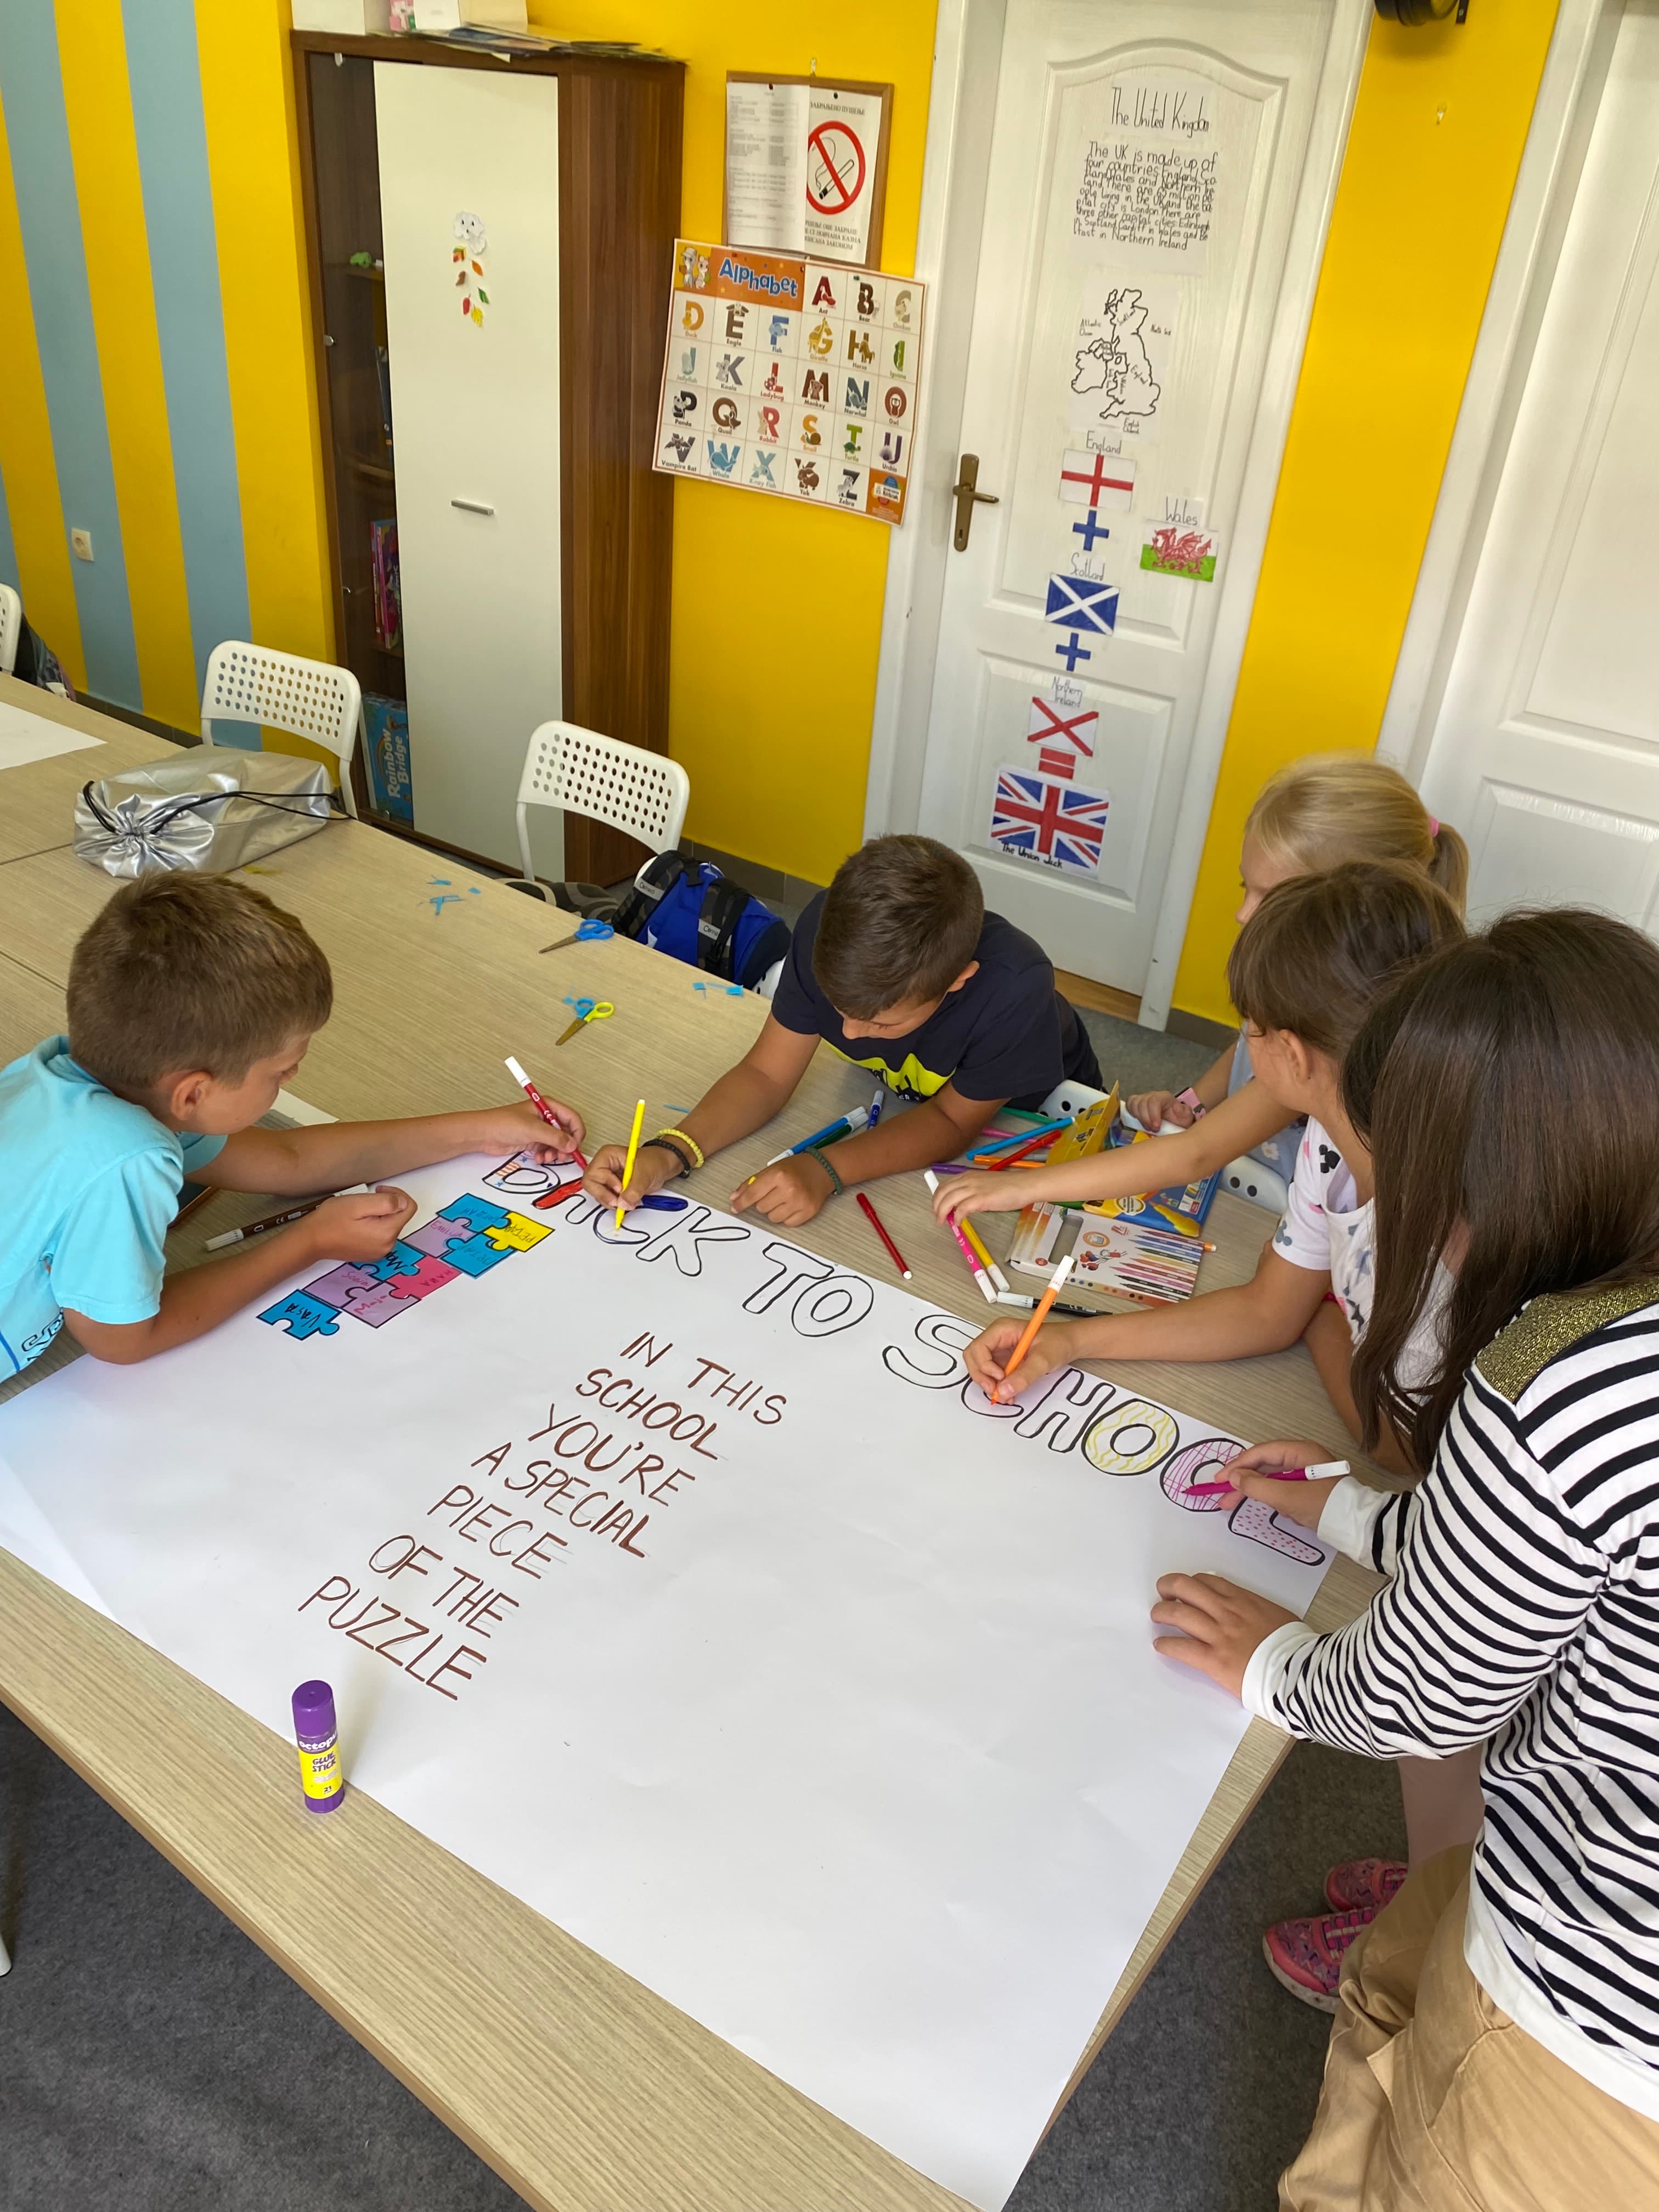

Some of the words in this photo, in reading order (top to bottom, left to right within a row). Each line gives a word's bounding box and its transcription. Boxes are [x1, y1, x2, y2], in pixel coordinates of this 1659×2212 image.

[1111, 87, 1128, 125] The
[1134, 88, 1167, 128] United
[1085, 154, 1104, 168] four
[1089, 141, 1108, 157] The
[1115, 144, 1128, 160] UK
[1134, 149, 1142, 163] is
[1147, 148, 1181, 166] made
[1184, 159, 1198, 172] up
[1201, 152, 1218, 172] of
[1139, 173, 1158, 186] and
[1137, 186, 1153, 195] are
[1125, 195, 1132, 203] in
[1121, 203, 1126, 212] is
[1112, 229, 1154, 246] Northern
[1159, 234, 1188, 250] Ireland
[1183, 228, 1198, 239] and
[718, 258, 798, 298] Alphabet
[726, 338, 742, 347] Eagle
[852, 362, 867, 370] Horse
[760, 390, 785, 403] Ladybug
[804, 399, 826, 410] Monkey
[844, 407, 867, 417] Narwhal
[675, 419, 692, 427] Panda
[718, 427, 733, 435] Quail
[759, 436, 777, 444] Rabbit
[1086, 430, 1122, 454] England
[662, 460, 686, 470] Vampire
[844, 454, 859, 462] Turtle
[713, 470, 730, 479] Whale
[882, 463, 898, 472] Urchin
[839, 498, 855, 507] Zebra
[1165, 495, 1198, 526] Wales
[1070, 552, 1105, 581] Scotland
[382, 729, 400, 798] Rainbow
[394, 735, 409, 785] Bridge
[1001, 841, 1015, 854] The
[1018, 845, 1040, 861] Union
[1043, 854, 1063, 869] Jack
[742, 1242, 874, 1338] TO
[353, 1294, 388, 1316] Maja
[620, 1331, 674, 1368] IN
[687, 1357, 788, 1425] THIS
[575, 1368, 721, 1461] SCHOOL
[527, 1403, 697, 1507] YOU'RE
[471, 1442, 512, 1476] A
[504, 1460, 646, 1559] SPECIAL
[426, 1484, 569, 1579] PIECE
[368, 1534, 443, 1580] OF
[432, 1565, 520, 1639] THE
[297, 1575, 487, 1702] PUZZLE
[312, 1751, 336, 1765] GLUE
[312, 1758, 336, 1772] STICK
